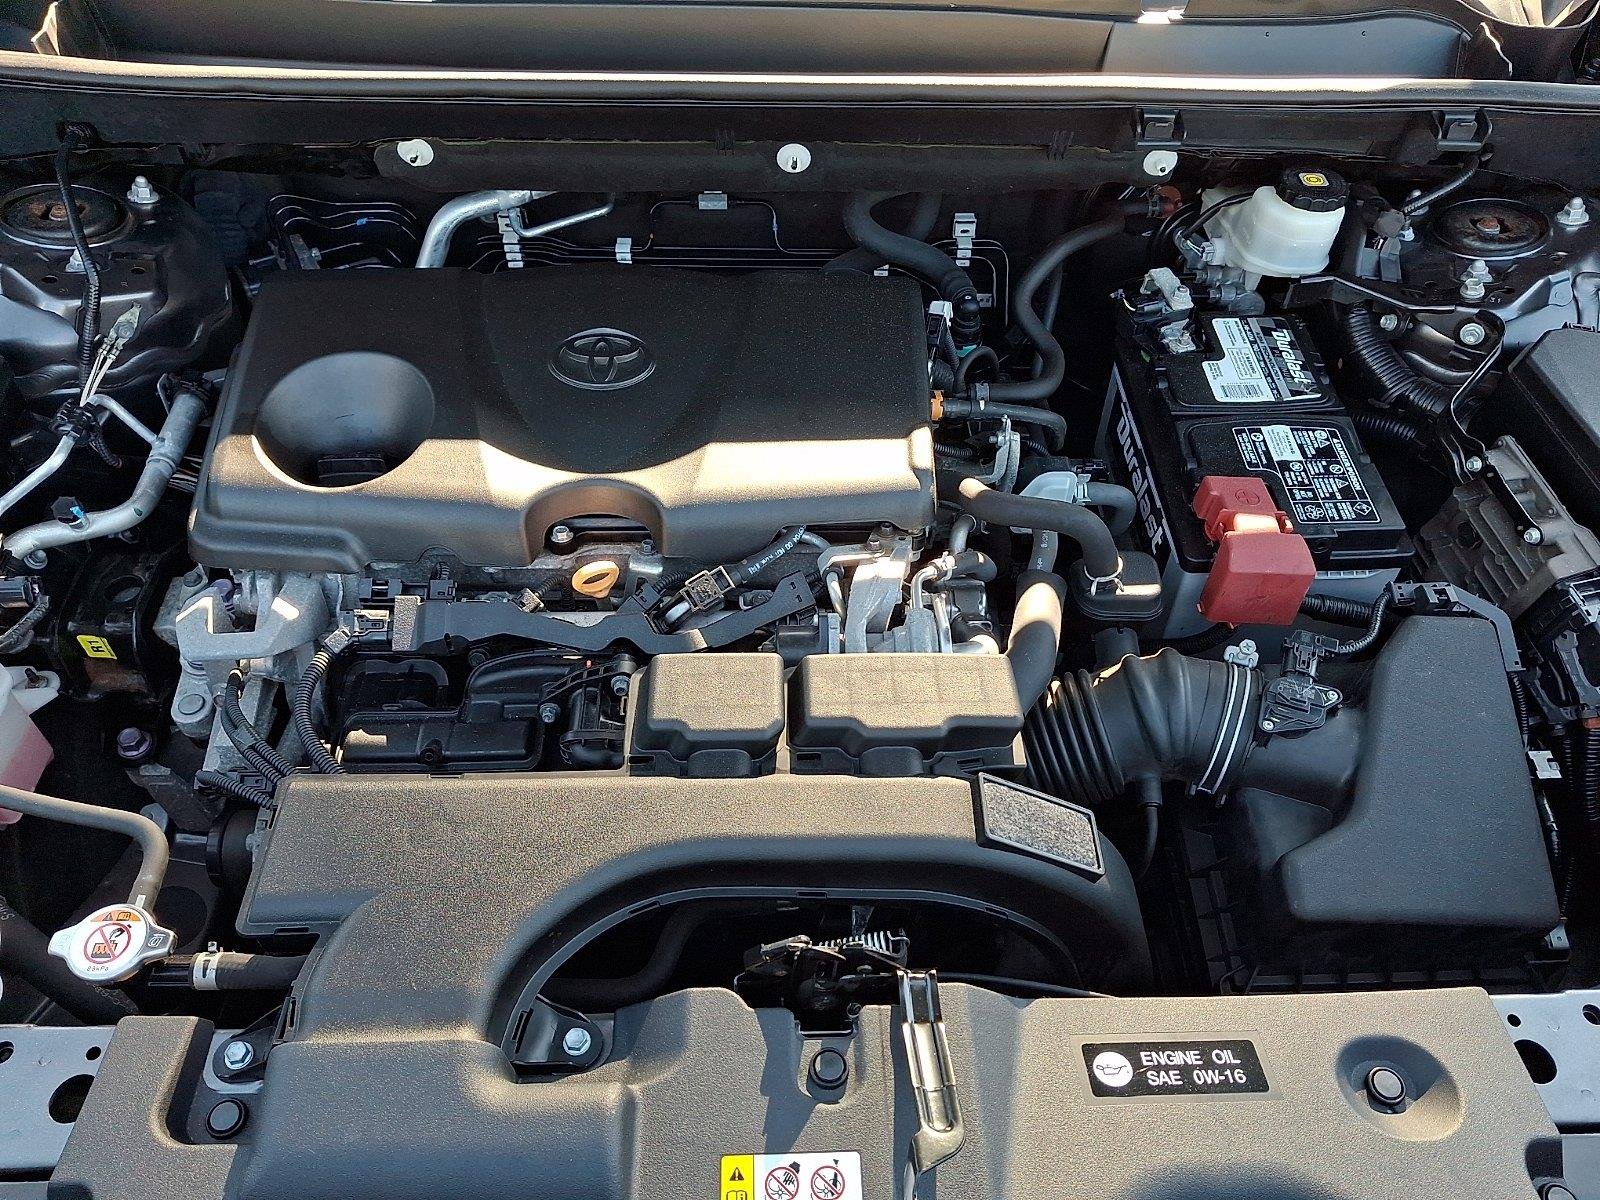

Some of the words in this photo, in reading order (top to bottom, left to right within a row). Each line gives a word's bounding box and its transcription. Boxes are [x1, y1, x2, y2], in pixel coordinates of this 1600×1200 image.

[1271, 328, 1312, 384] Duralast
[1116, 402, 1165, 556] Duralast
[1334, 443, 1351, 467] DANGER
[1346, 467, 1362, 491] POISON
[87, 640, 106, 653] R1
[1140, 1050, 1203, 1067] ENGINE
[1211, 1049, 1241, 1065] OIL
[1147, 1069, 1184, 1086] SAE
[1193, 1069, 1247, 1085] 0W-16
